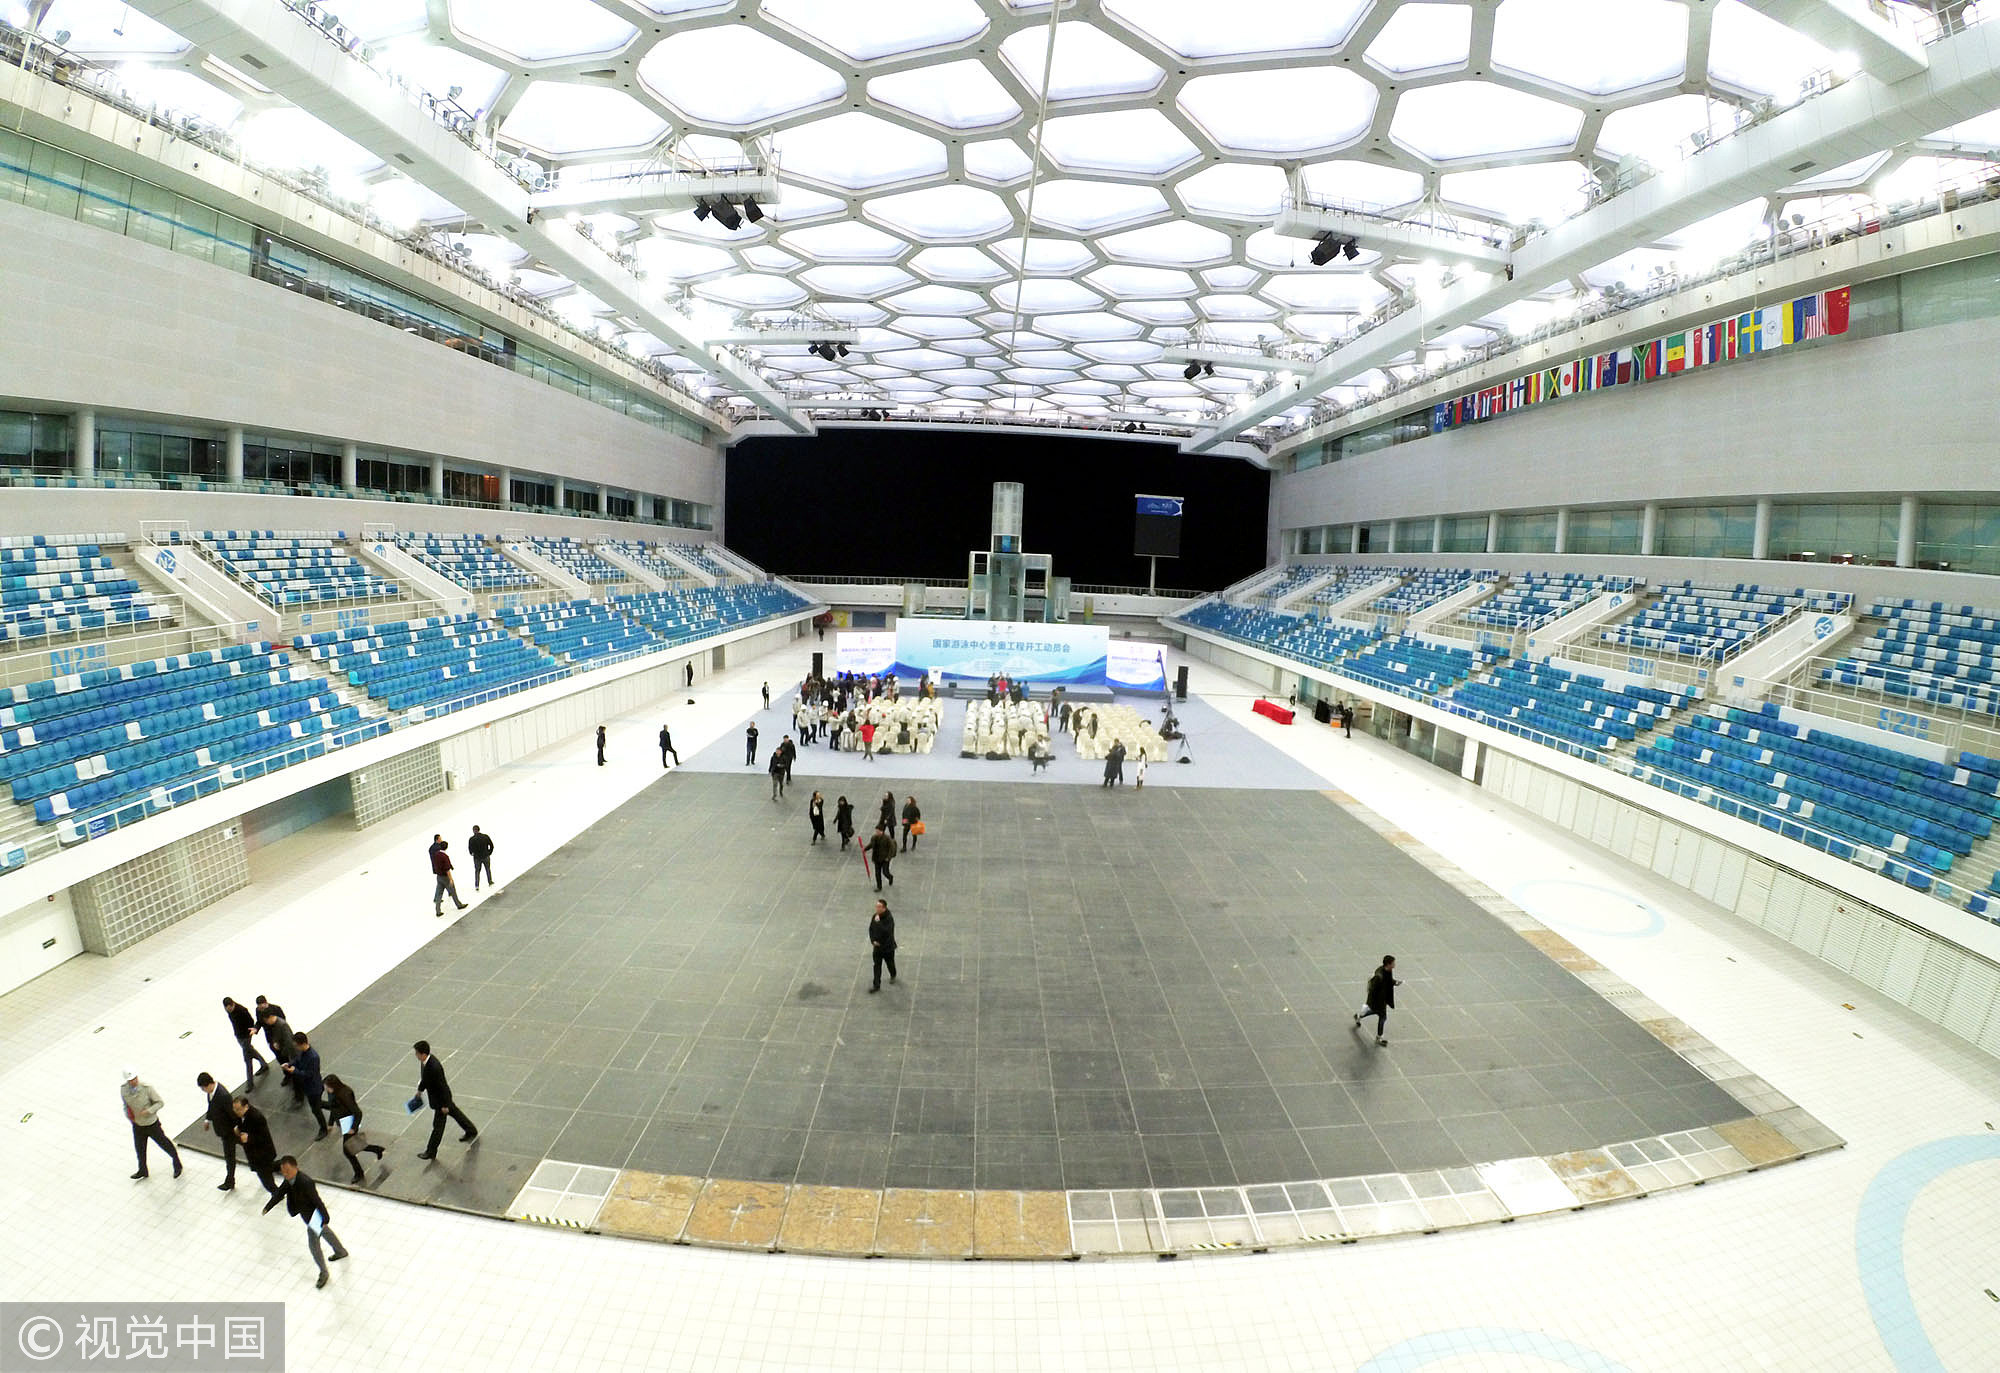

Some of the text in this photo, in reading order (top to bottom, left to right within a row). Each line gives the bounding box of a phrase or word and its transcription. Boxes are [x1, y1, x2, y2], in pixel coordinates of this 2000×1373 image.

[932, 638, 1071, 653] 国家游泳中心冬奥工程开工动员会
[50, 647, 85, 677] N2
[1877, 707, 1908, 735] S2
